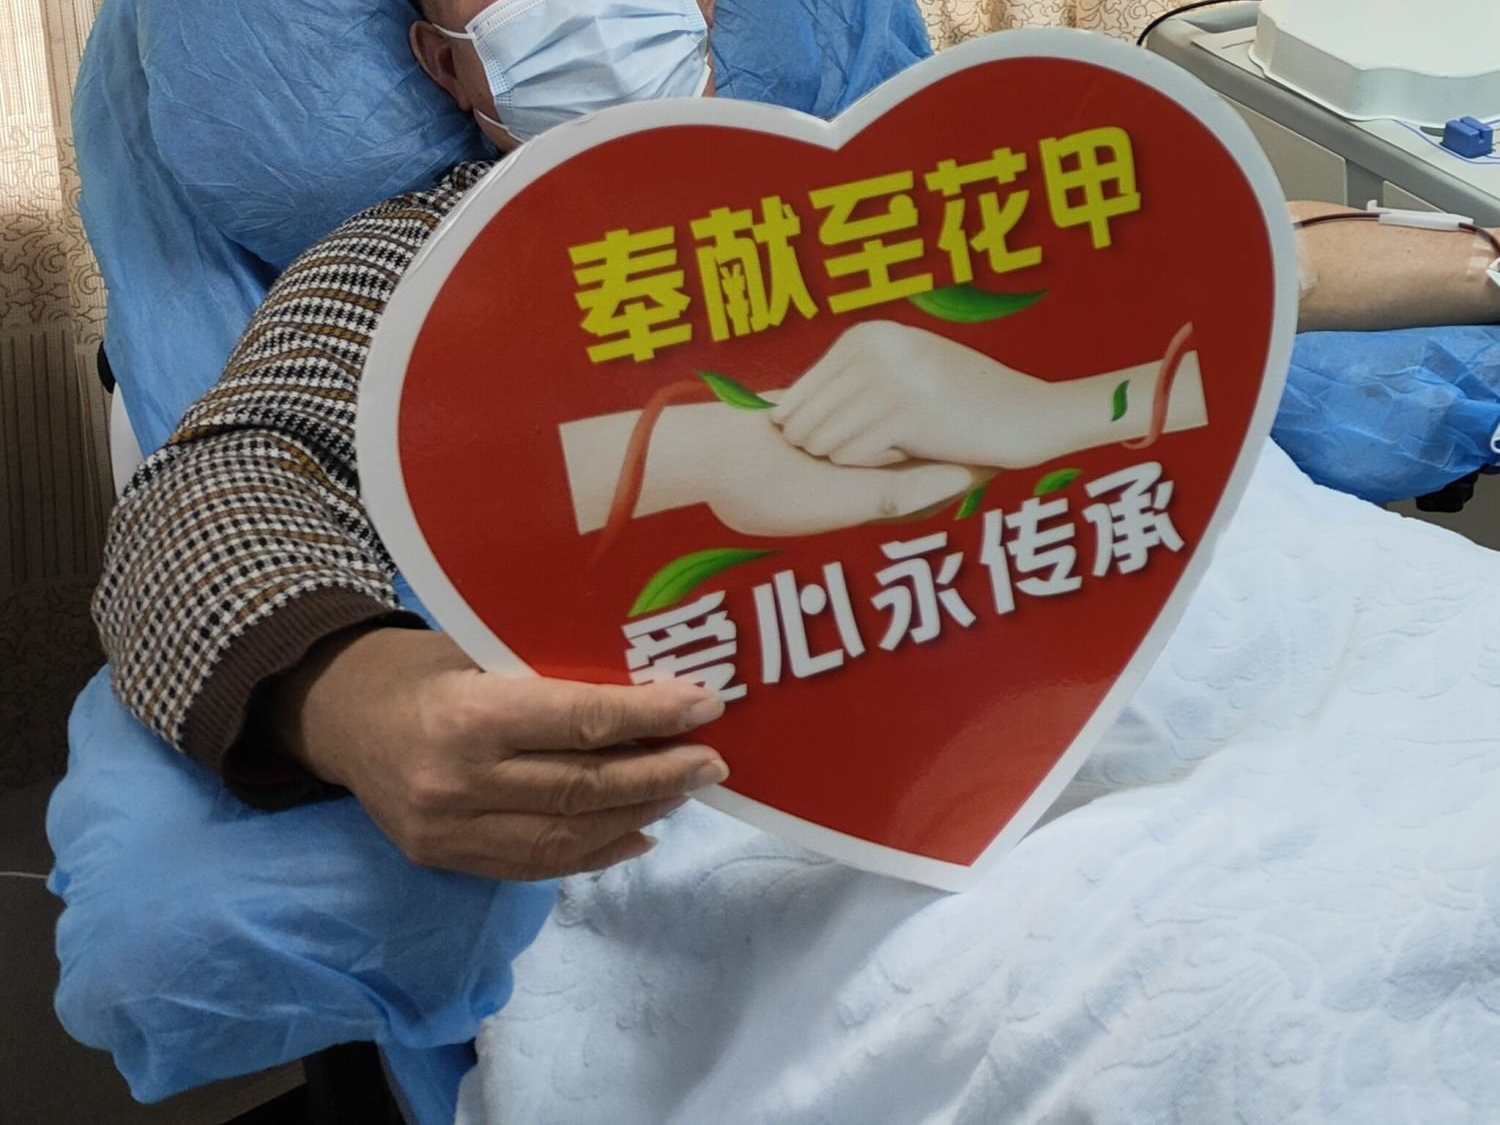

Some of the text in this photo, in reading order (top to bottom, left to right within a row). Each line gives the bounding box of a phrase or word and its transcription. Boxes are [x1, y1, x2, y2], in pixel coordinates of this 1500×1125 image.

[569, 125, 1143, 363] 奉献至花甲
[622, 460, 1186, 706] 爱心永传承
